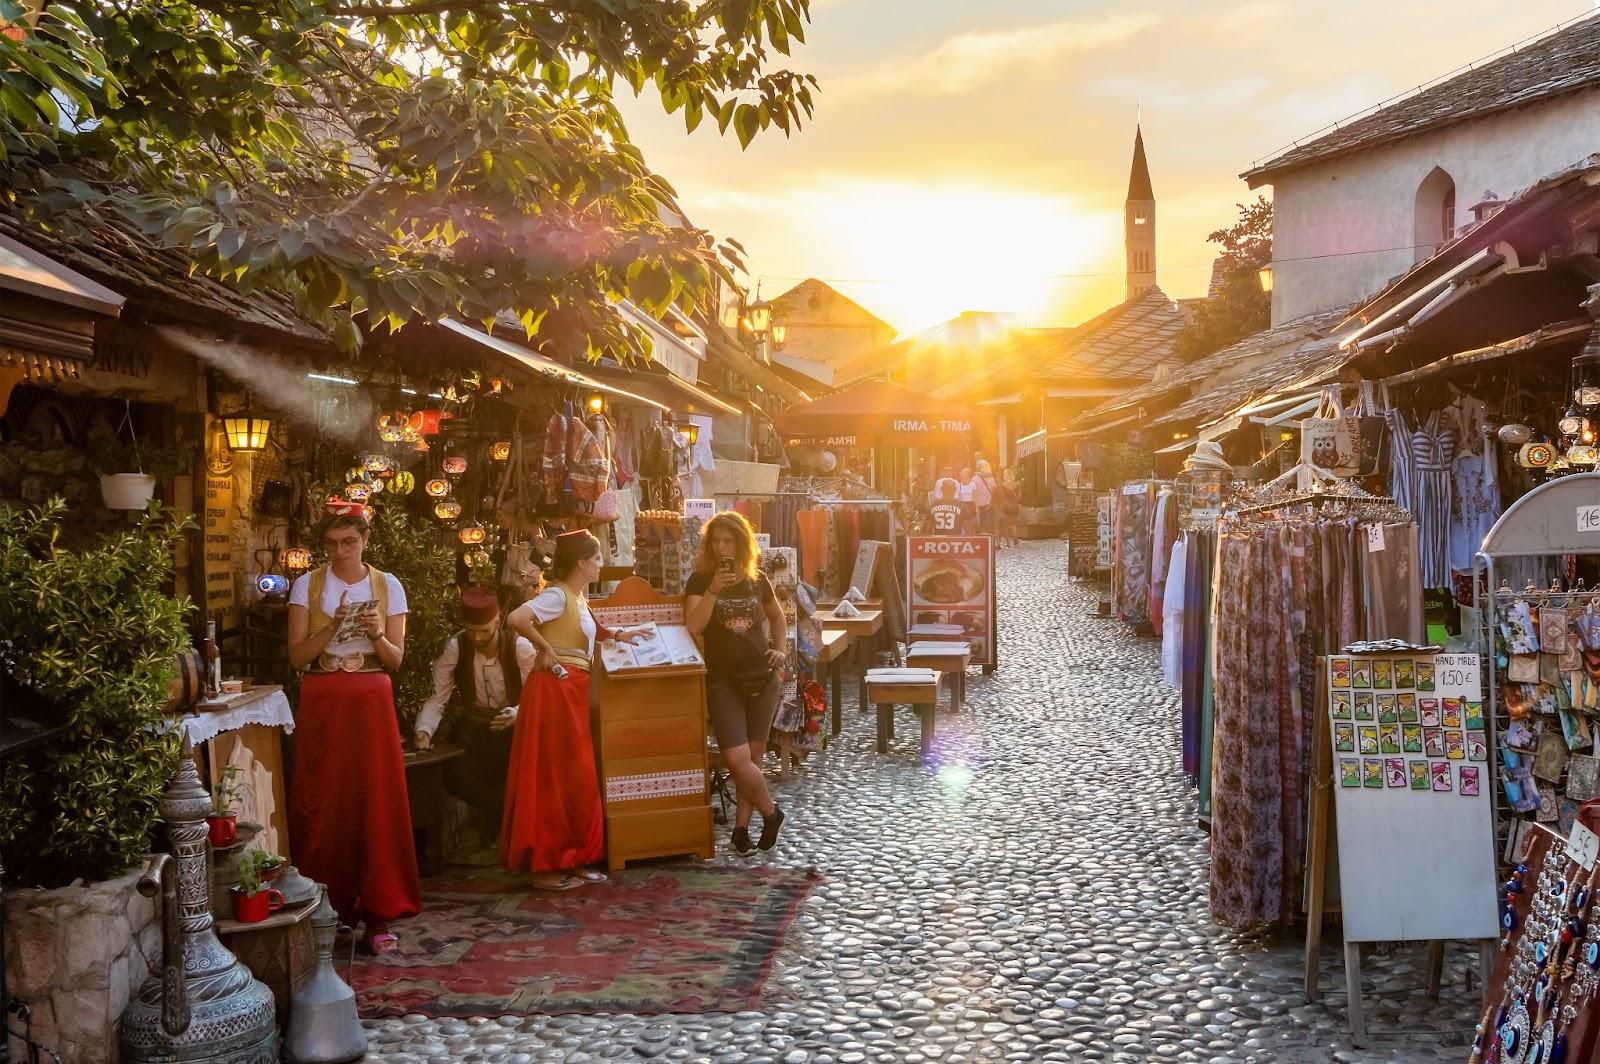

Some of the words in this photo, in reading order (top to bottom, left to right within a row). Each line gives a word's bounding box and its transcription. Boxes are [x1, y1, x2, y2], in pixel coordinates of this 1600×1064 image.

[894, 420, 928, 432] IRMA
[940, 420, 971, 432] TIMA
[1345, 417, 1360, 455] DREAMS
[934, 512, 956, 530] 53
[1581, 509, 1600, 528] 1€
[1435, 656, 1454, 666] HAND
[1457, 656, 1477, 666] MADE
